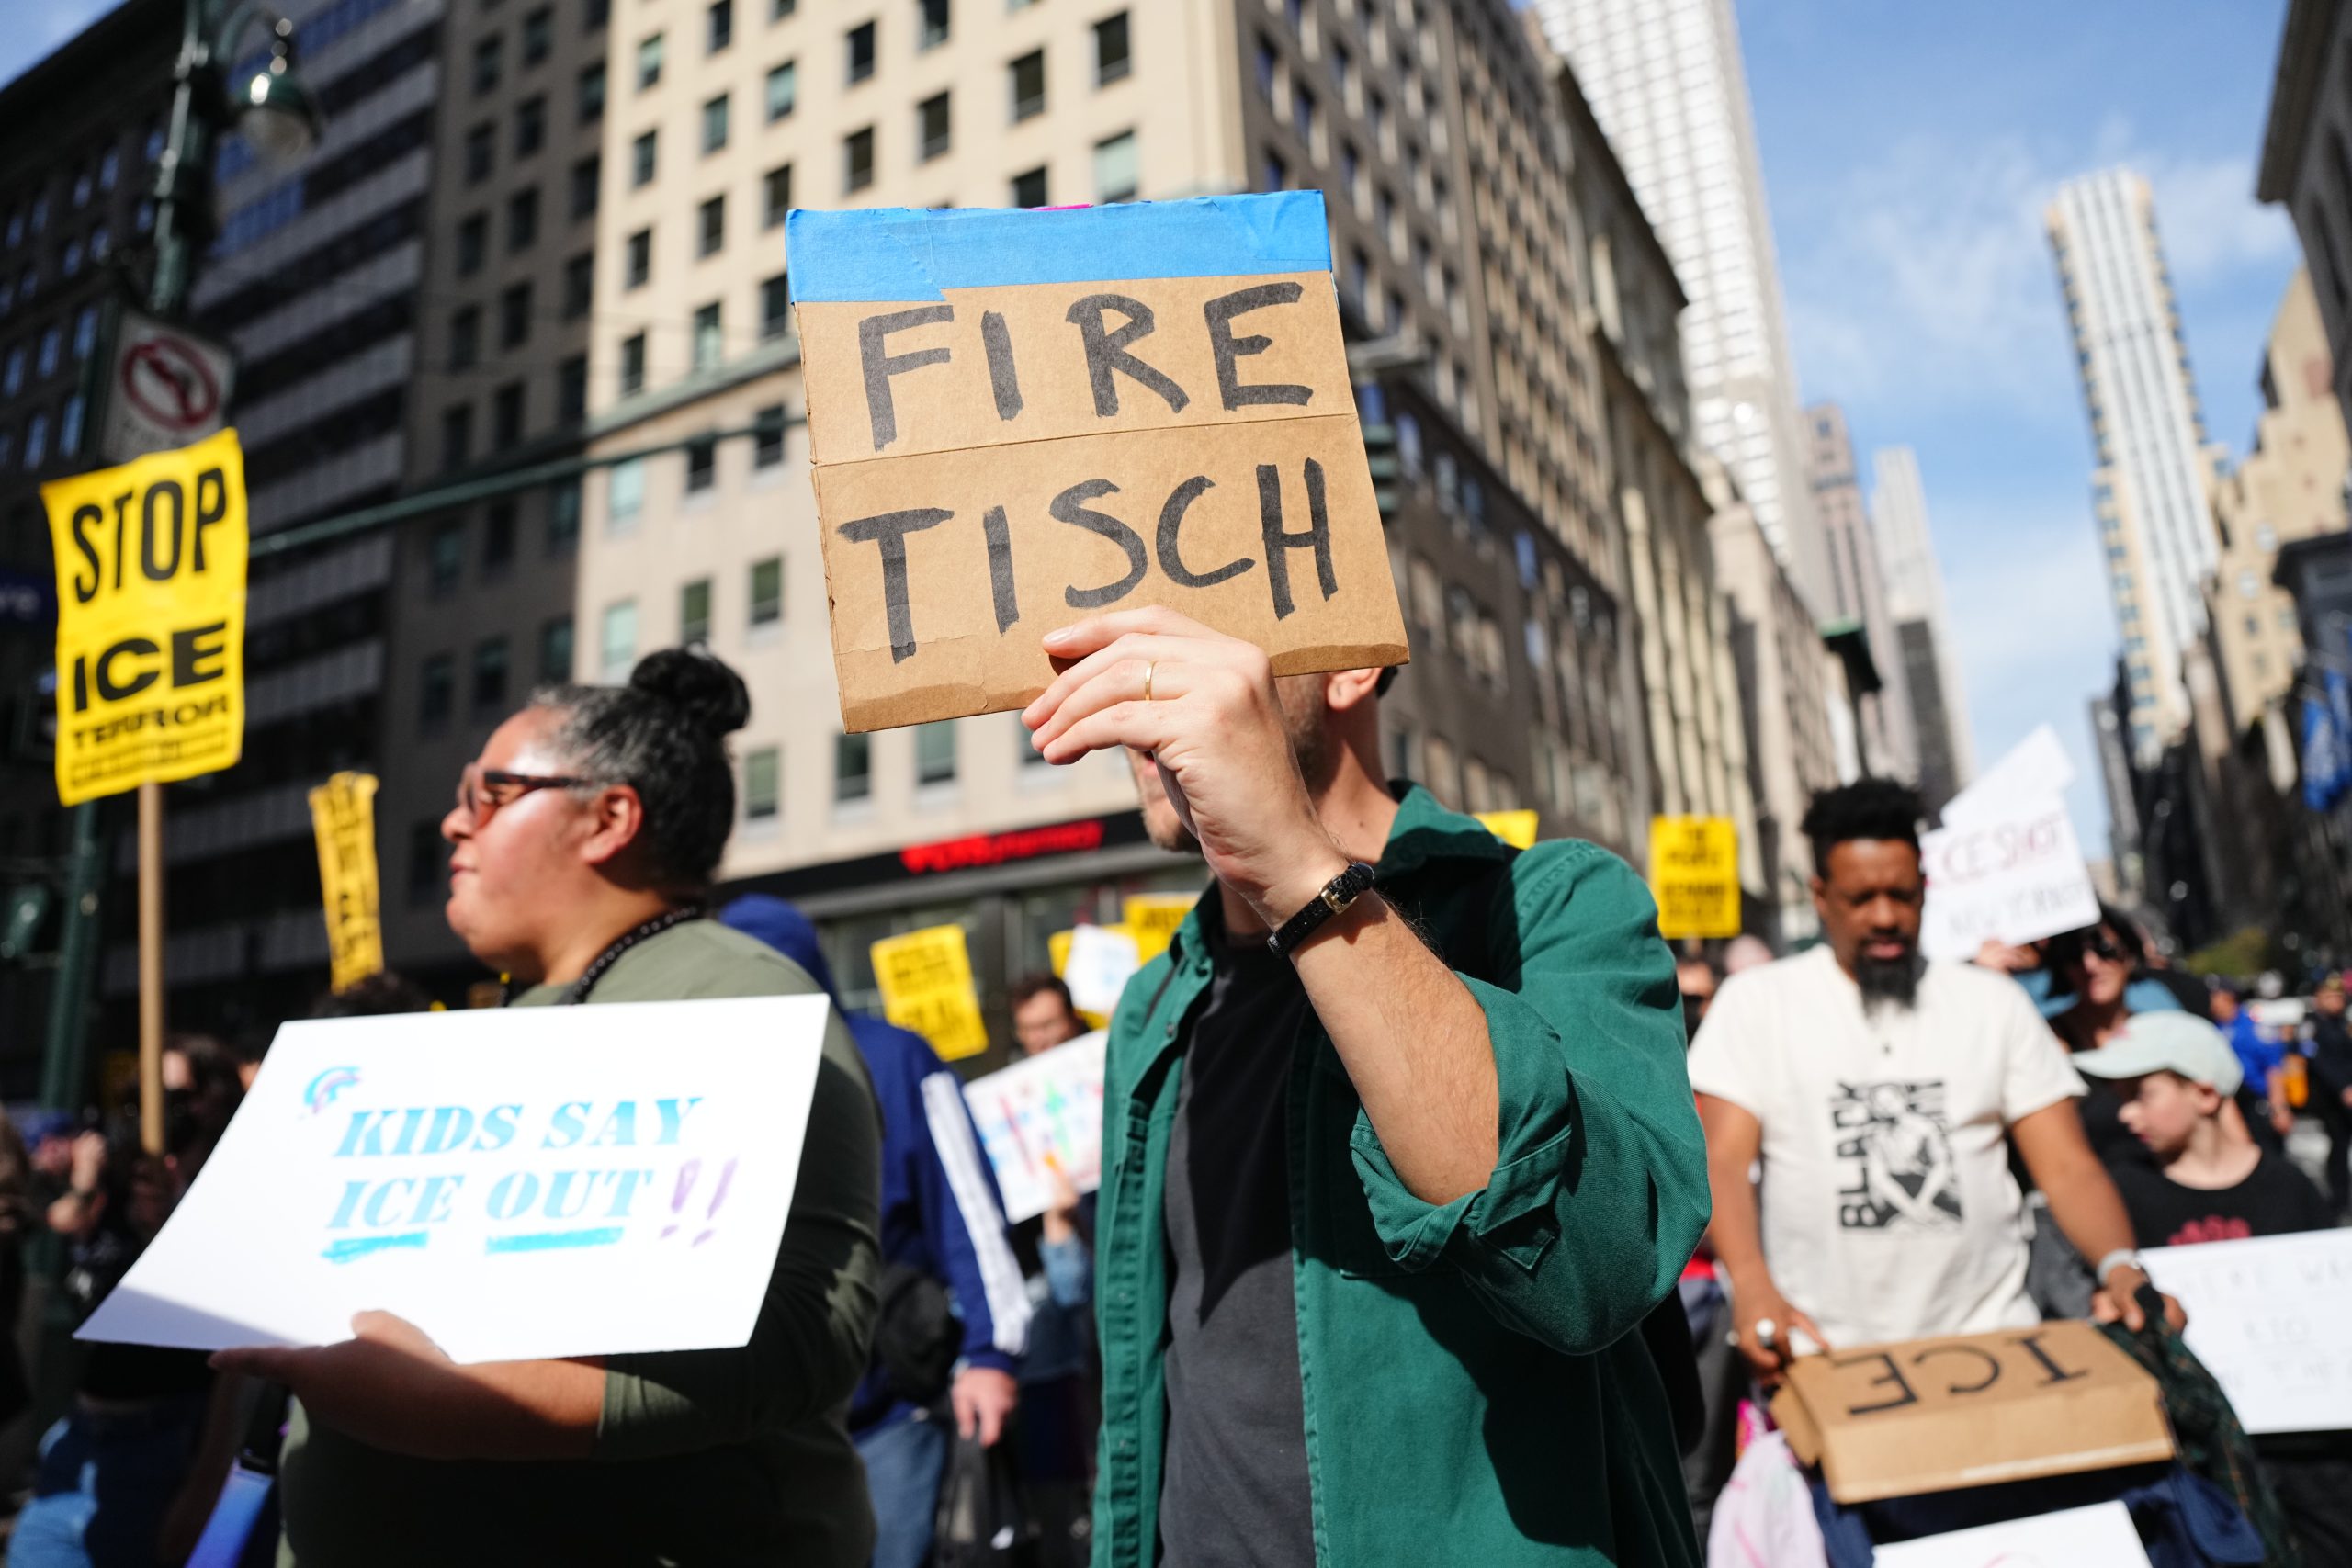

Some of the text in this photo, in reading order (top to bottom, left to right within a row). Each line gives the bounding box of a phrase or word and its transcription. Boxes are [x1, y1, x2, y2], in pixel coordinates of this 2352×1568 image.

[858, 281, 1314, 452] FIRE
[72, 467, 227, 604] STOP
[835, 457, 1338, 664] TISCH
[73, 621, 227, 713] ICE
[72, 694, 229, 749] TERROR
[331, 1096, 706, 1158] KIDS SAY
[327, 1172, 466, 1230] ICE
[1829, 1332, 2091, 1416] ICE
